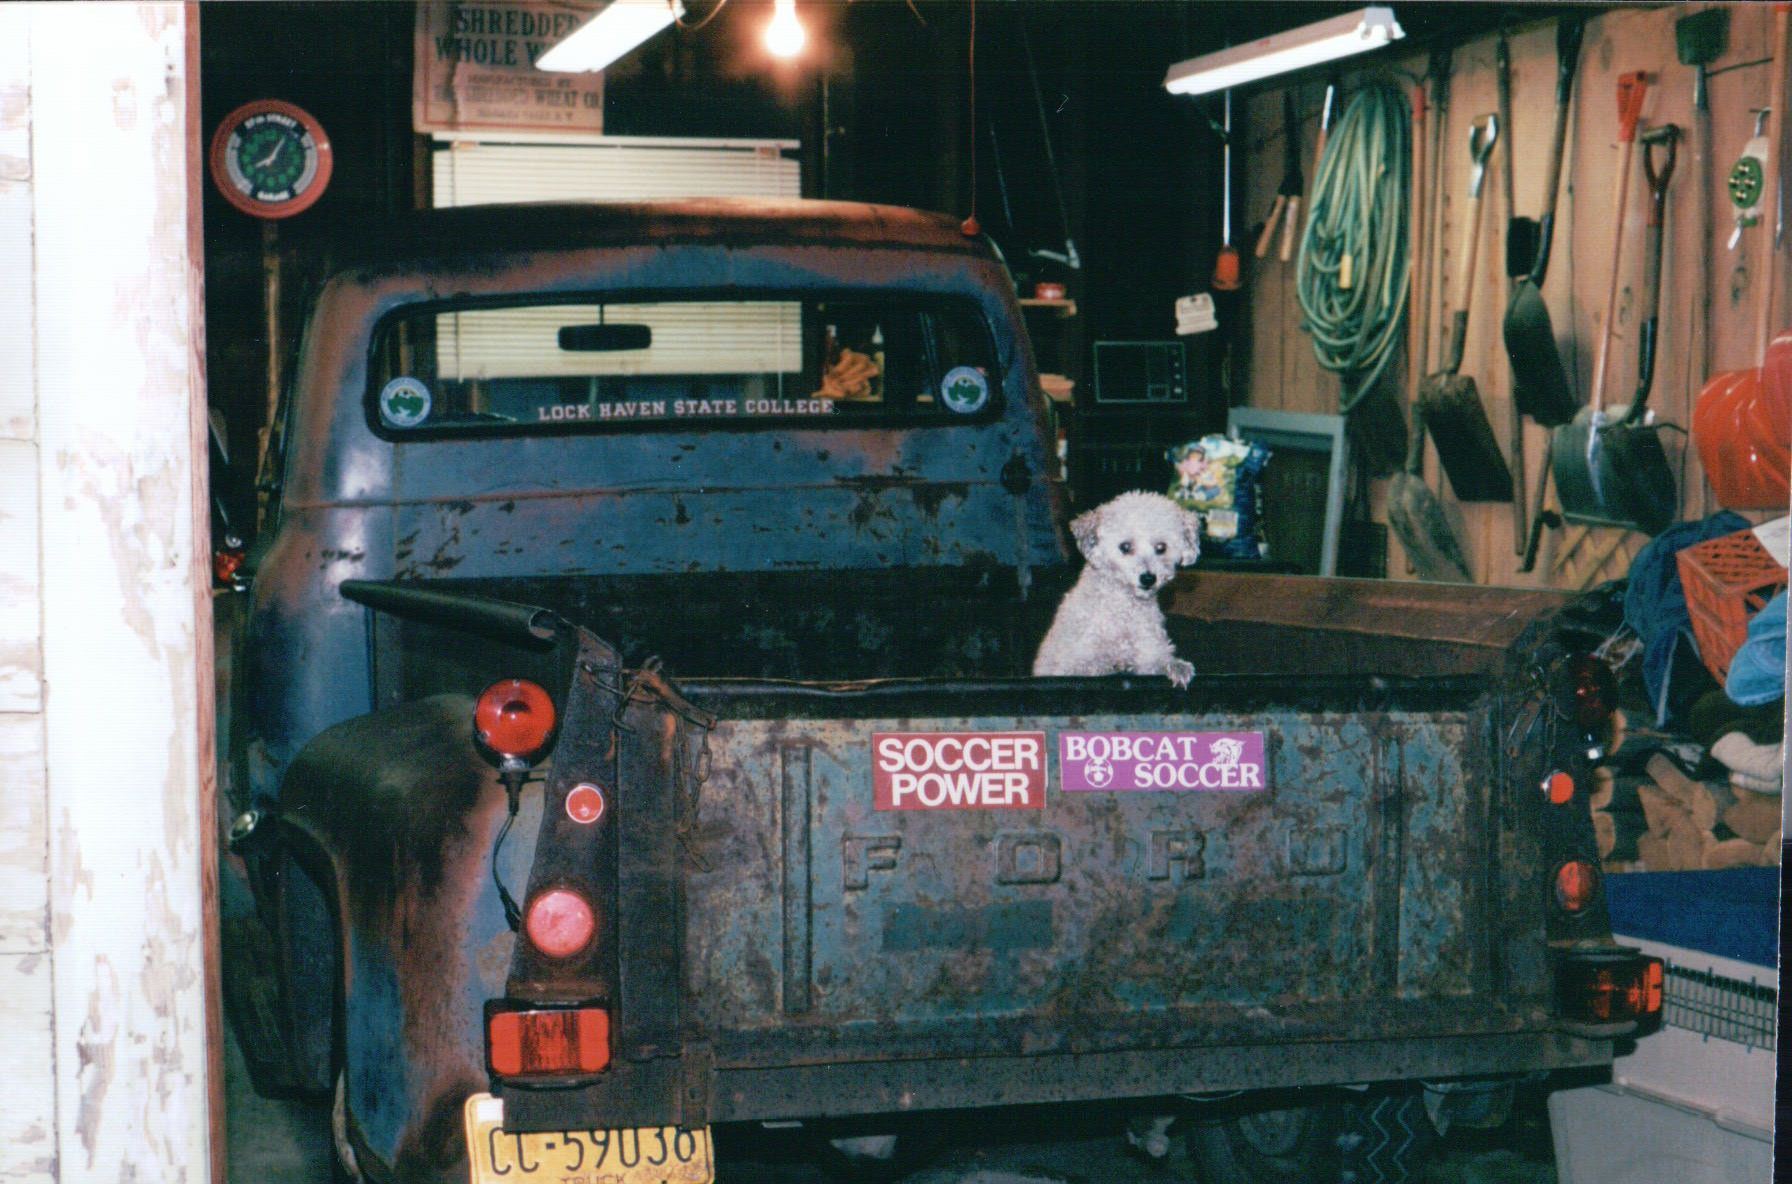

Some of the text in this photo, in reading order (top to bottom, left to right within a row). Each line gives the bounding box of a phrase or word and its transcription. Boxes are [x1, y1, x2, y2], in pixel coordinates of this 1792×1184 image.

[435, 36, 518, 65] WHOLE
[539, 399, 834, 421] LOCK HAVEN STATE COLLEGE
[878, 738, 1039, 772] SOCCER
[1065, 736, 1198, 761] BOBCAT
[891, 772, 1030, 806] POWER
[1133, 763, 1261, 788] SOCCER
[841, 827, 1348, 891] FORD
